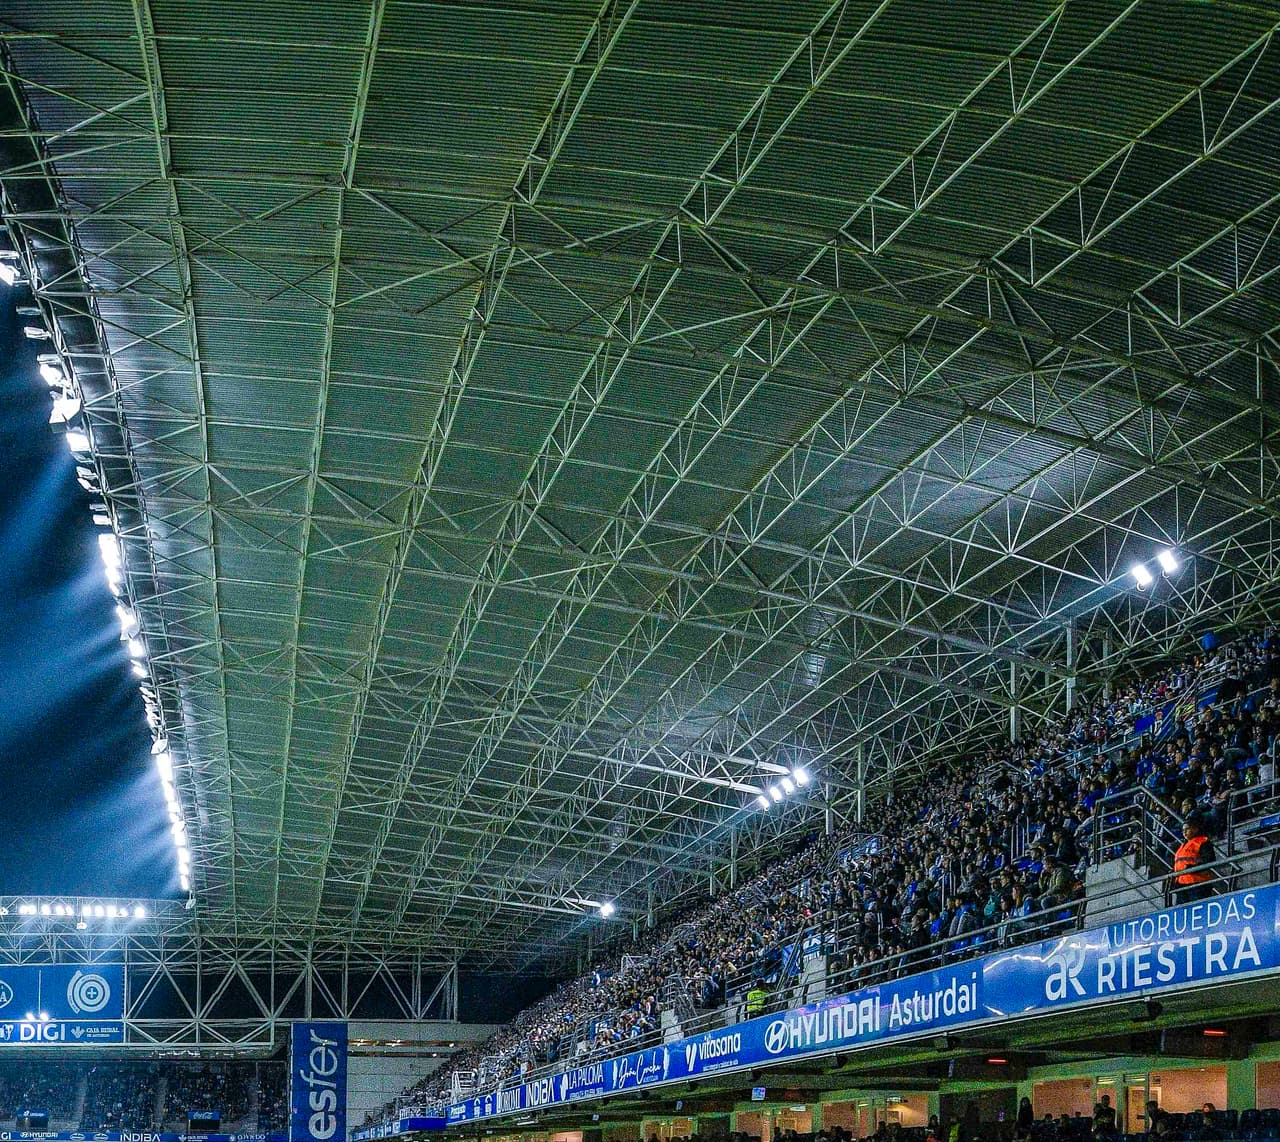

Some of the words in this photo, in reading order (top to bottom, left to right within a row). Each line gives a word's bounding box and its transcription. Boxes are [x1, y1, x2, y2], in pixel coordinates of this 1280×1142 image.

[1100, 894, 1256, 949] AUTORUEDAS
[1097, 926, 1262, 994] RIESTRA
[790, 996, 880, 1049] HYUNDAI
[888, 972, 977, 1028] Asturdai
[20, 1023, 66, 1041] DIGI
[698, 1033, 741, 1060] vitasana
[299, 1029, 338, 1140] esfer
[569, 1071, 577, 1089] LA
[577, 1064, 604, 1087] PALOMA
[525, 1077, 555, 1107] INDIBA
[120, 1132, 161, 1142] INDIBA
